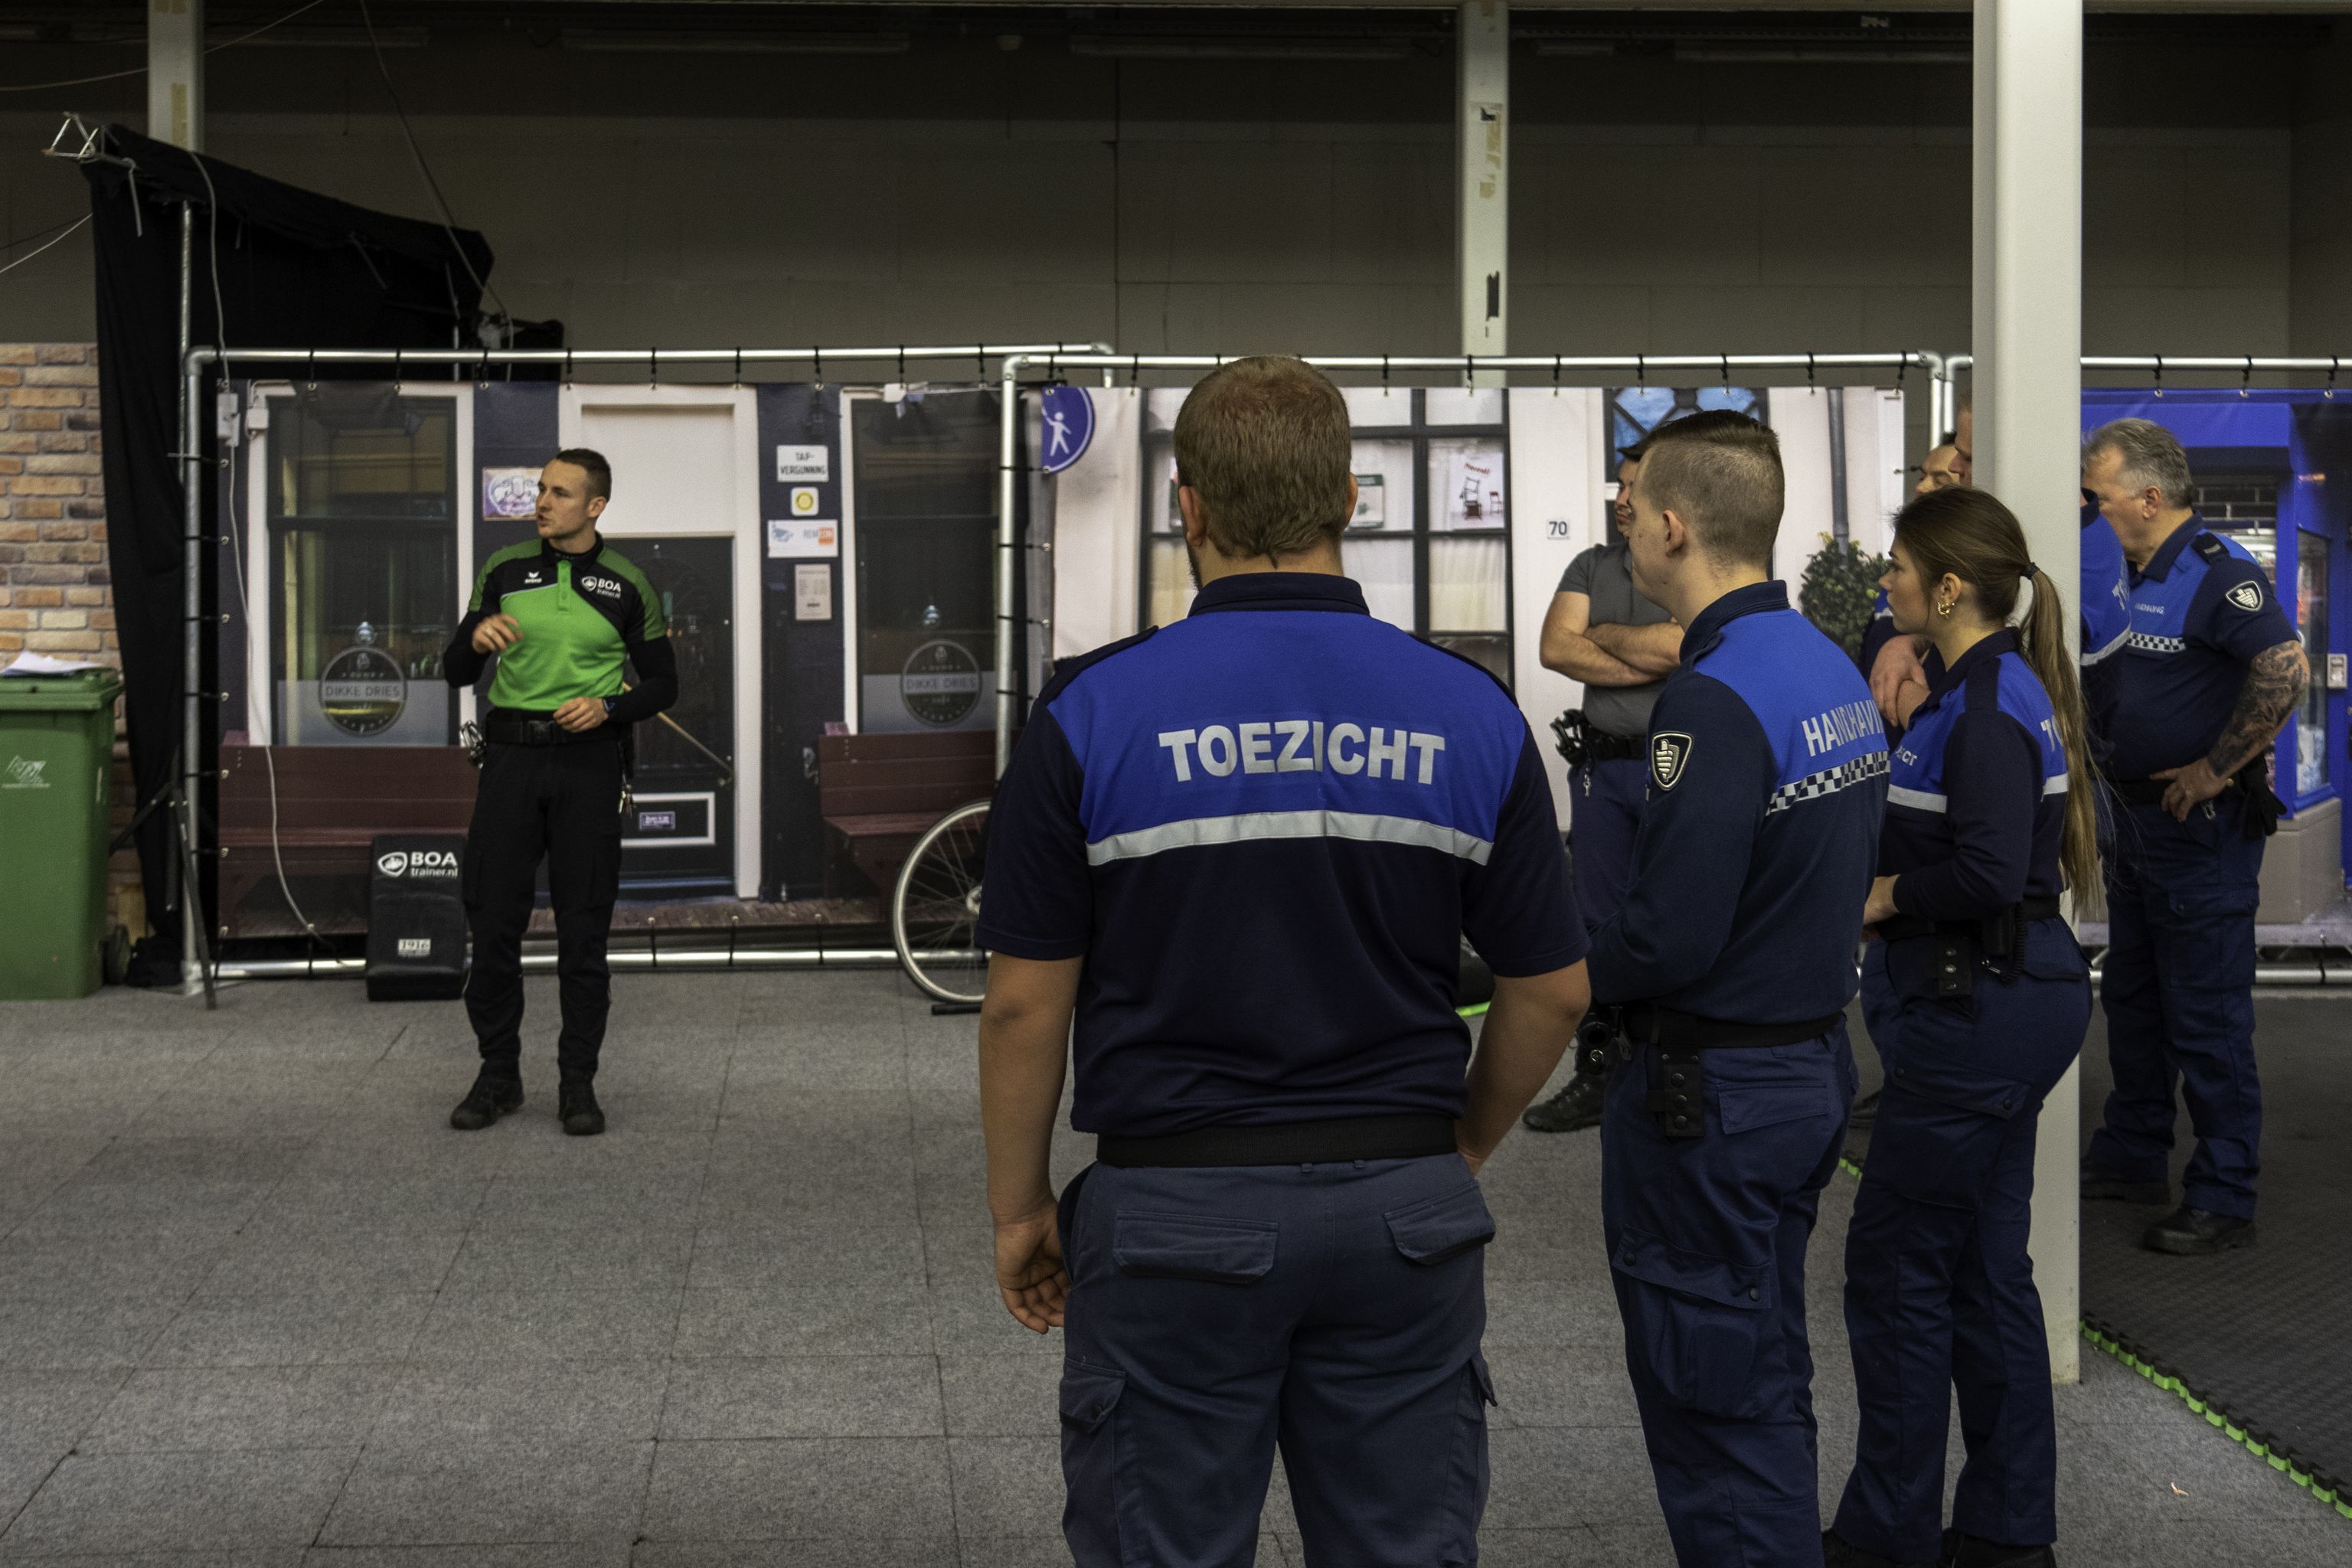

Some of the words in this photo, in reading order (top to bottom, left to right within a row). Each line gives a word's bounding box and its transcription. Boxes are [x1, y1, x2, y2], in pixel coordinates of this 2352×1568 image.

[1548, 521, 1568, 536] 70
[597, 577, 622, 593] BOA
[1158, 720, 1446, 785] TOEZICHT
[410, 851, 458, 867] BOA
[410, 867, 459, 879] trainer.nl
